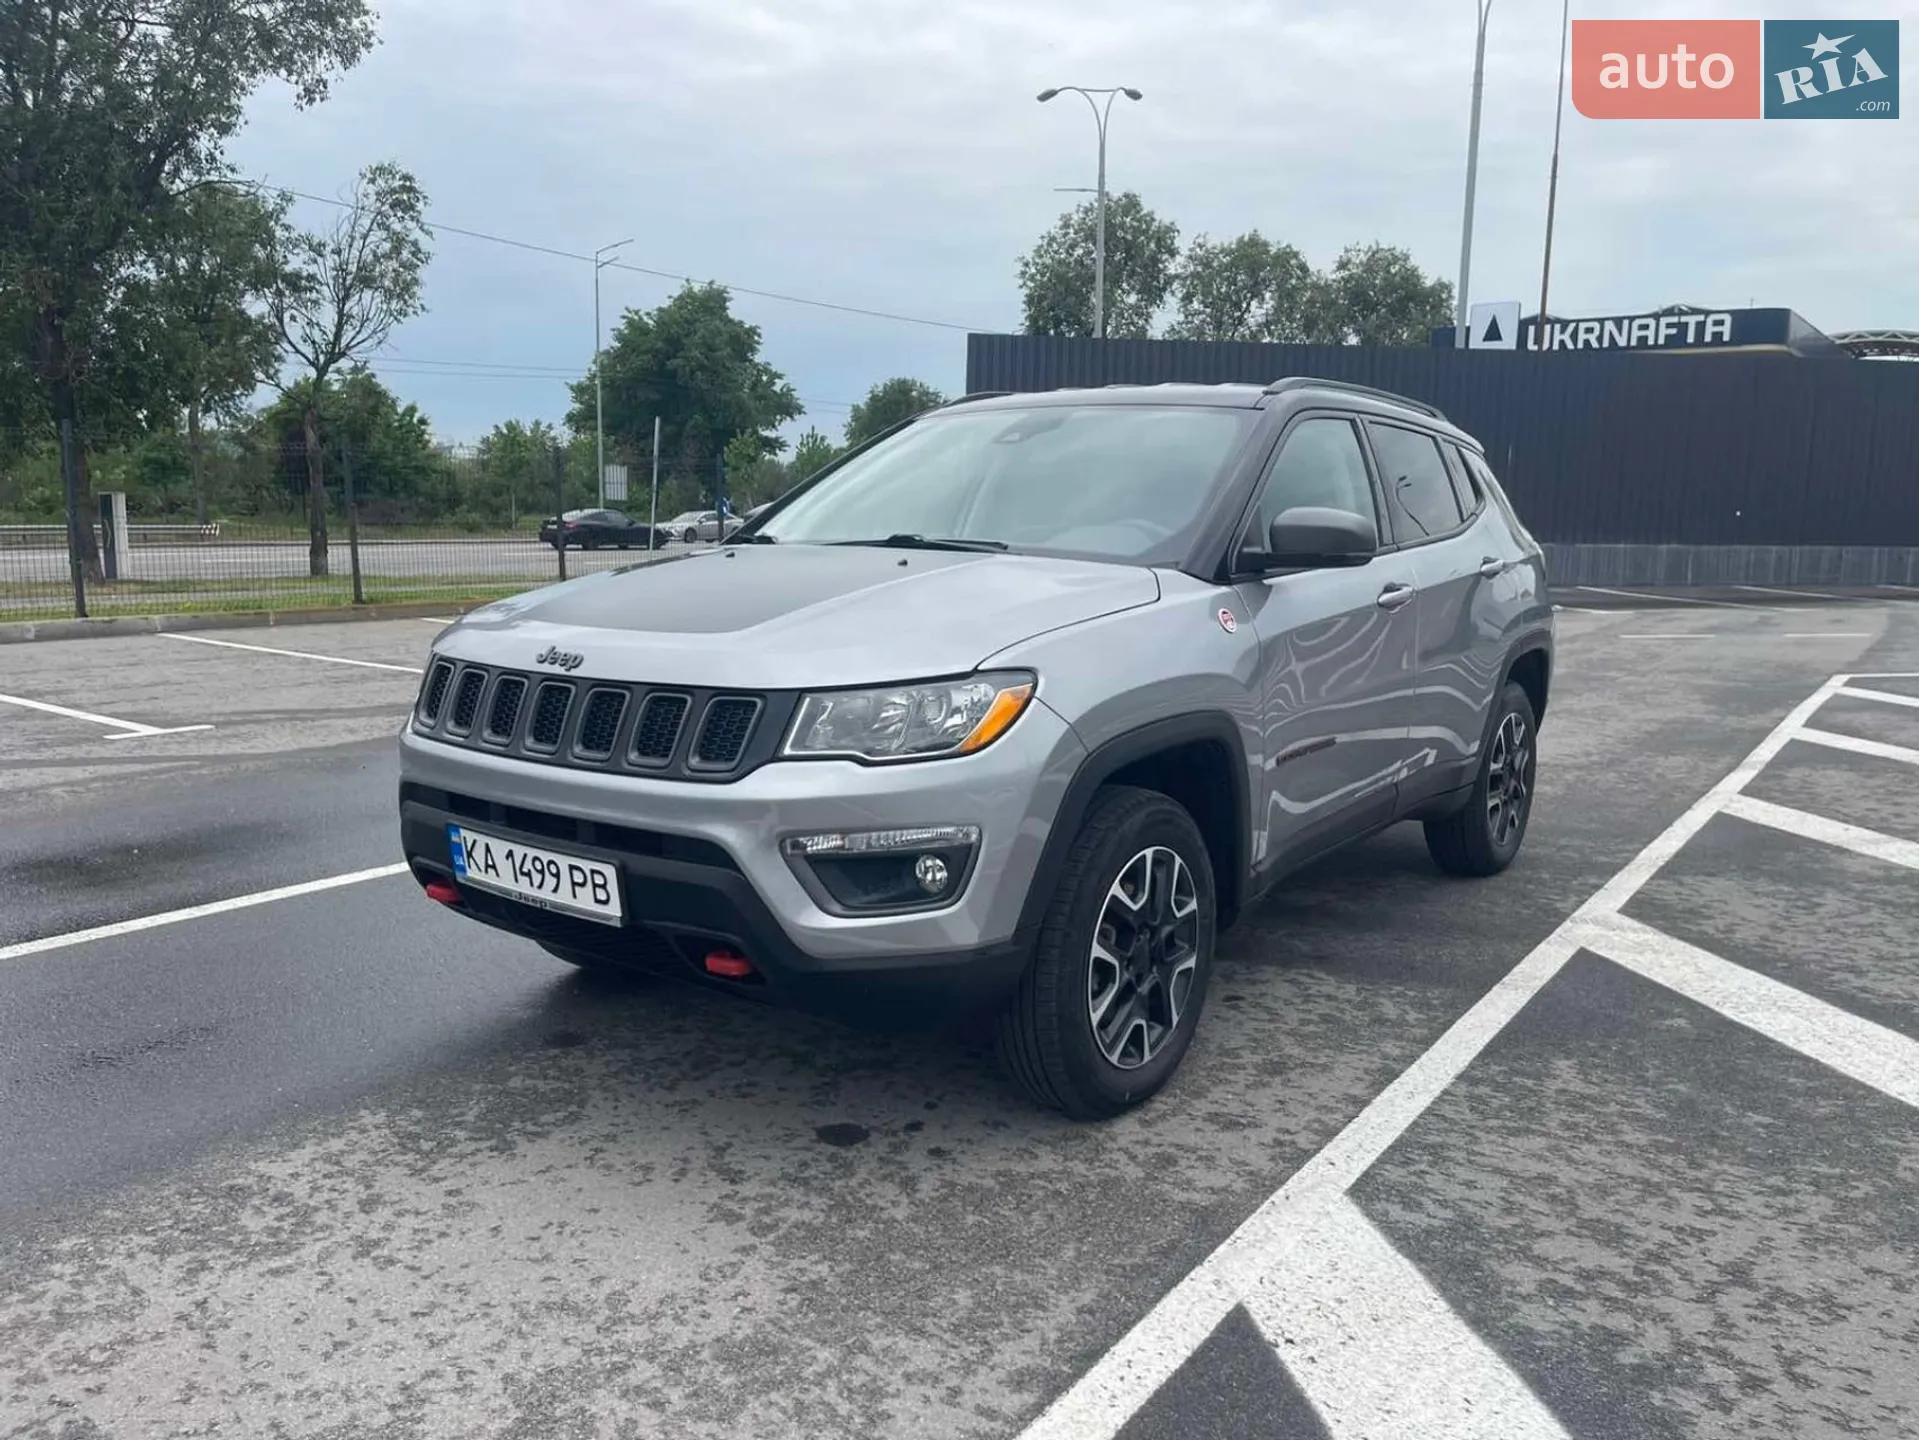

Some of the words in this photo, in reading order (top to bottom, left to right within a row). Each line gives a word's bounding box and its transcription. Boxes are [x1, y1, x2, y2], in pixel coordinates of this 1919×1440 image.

[1526, 313, 1732, 351] UKRNAFTA
[536, 645, 584, 672] Jeep
[463, 835, 500, 878] KA
[505, 848, 561, 894] 1499
[568, 863, 611, 906] PB
